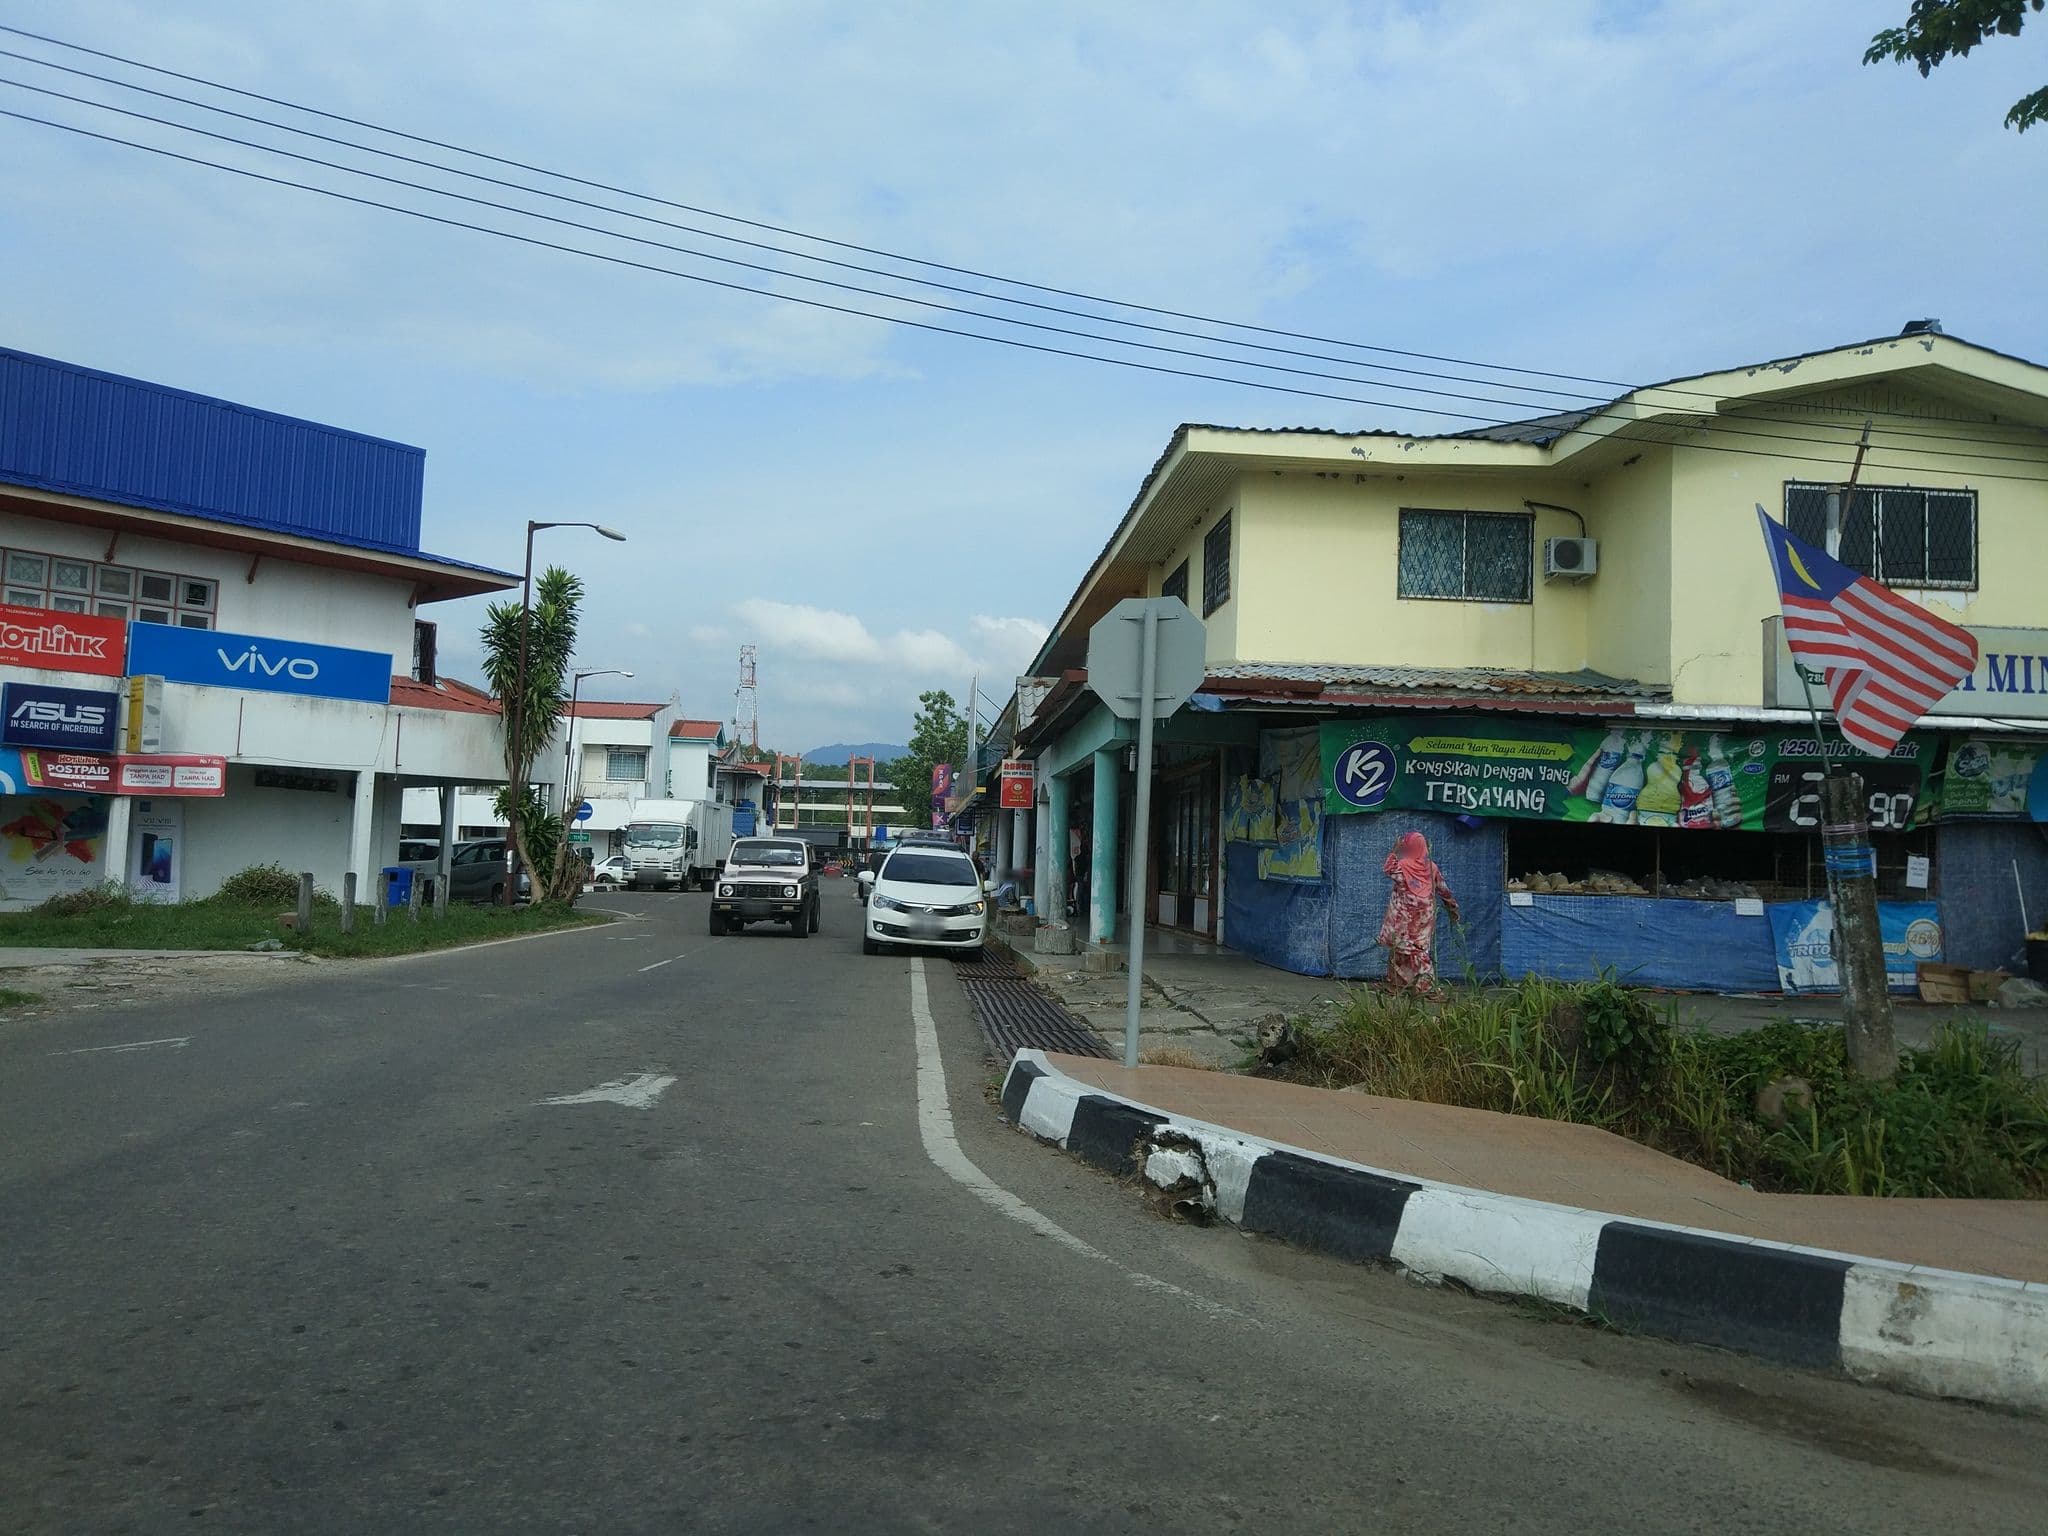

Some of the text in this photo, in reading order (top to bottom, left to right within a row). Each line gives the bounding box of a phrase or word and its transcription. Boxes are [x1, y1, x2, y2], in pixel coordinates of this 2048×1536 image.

[217, 645, 319, 680] vivo
[11, 700, 106, 725] ASUS
[10, 719, 104, 735] IN SEARCH OF INCREDIBLE
[1426, 740, 1557, 758] Selamat Hari Raya Aidilfitri
[47, 763, 110, 775] POSTPAID
[1345, 749, 1388, 798] K2
[1774, 774, 1790, 784] RM
[1425, 781, 1546, 813] TERSAYANG
